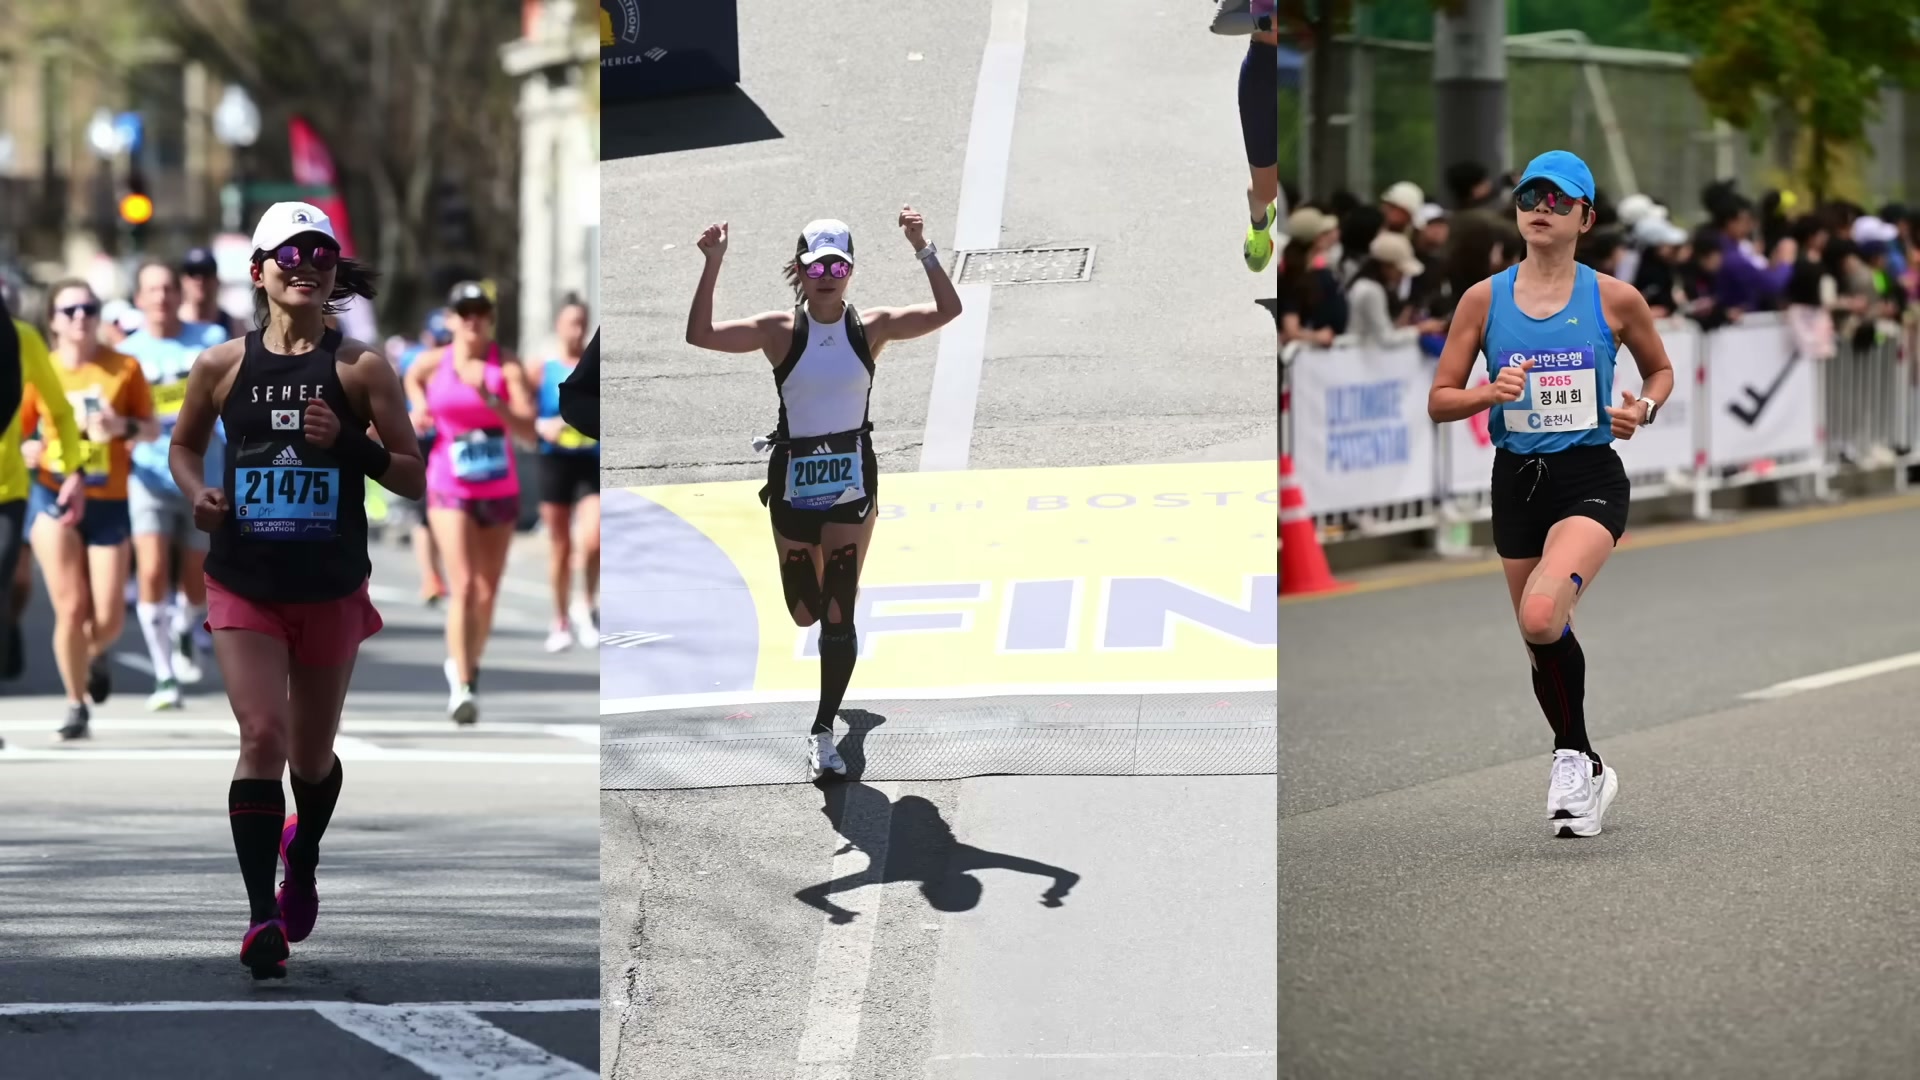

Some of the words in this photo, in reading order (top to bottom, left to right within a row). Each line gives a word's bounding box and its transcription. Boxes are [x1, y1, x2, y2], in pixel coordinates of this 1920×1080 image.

[623, 0, 637, 34] THON
[1531, 352, 1583, 367] 신한은행
[1540, 375, 1572, 387] 9265
[272, 457, 302, 465] adidas
[794, 457, 853, 487] 20202
[245, 470, 329, 504] 21475
[239, 506, 247, 516] 6
